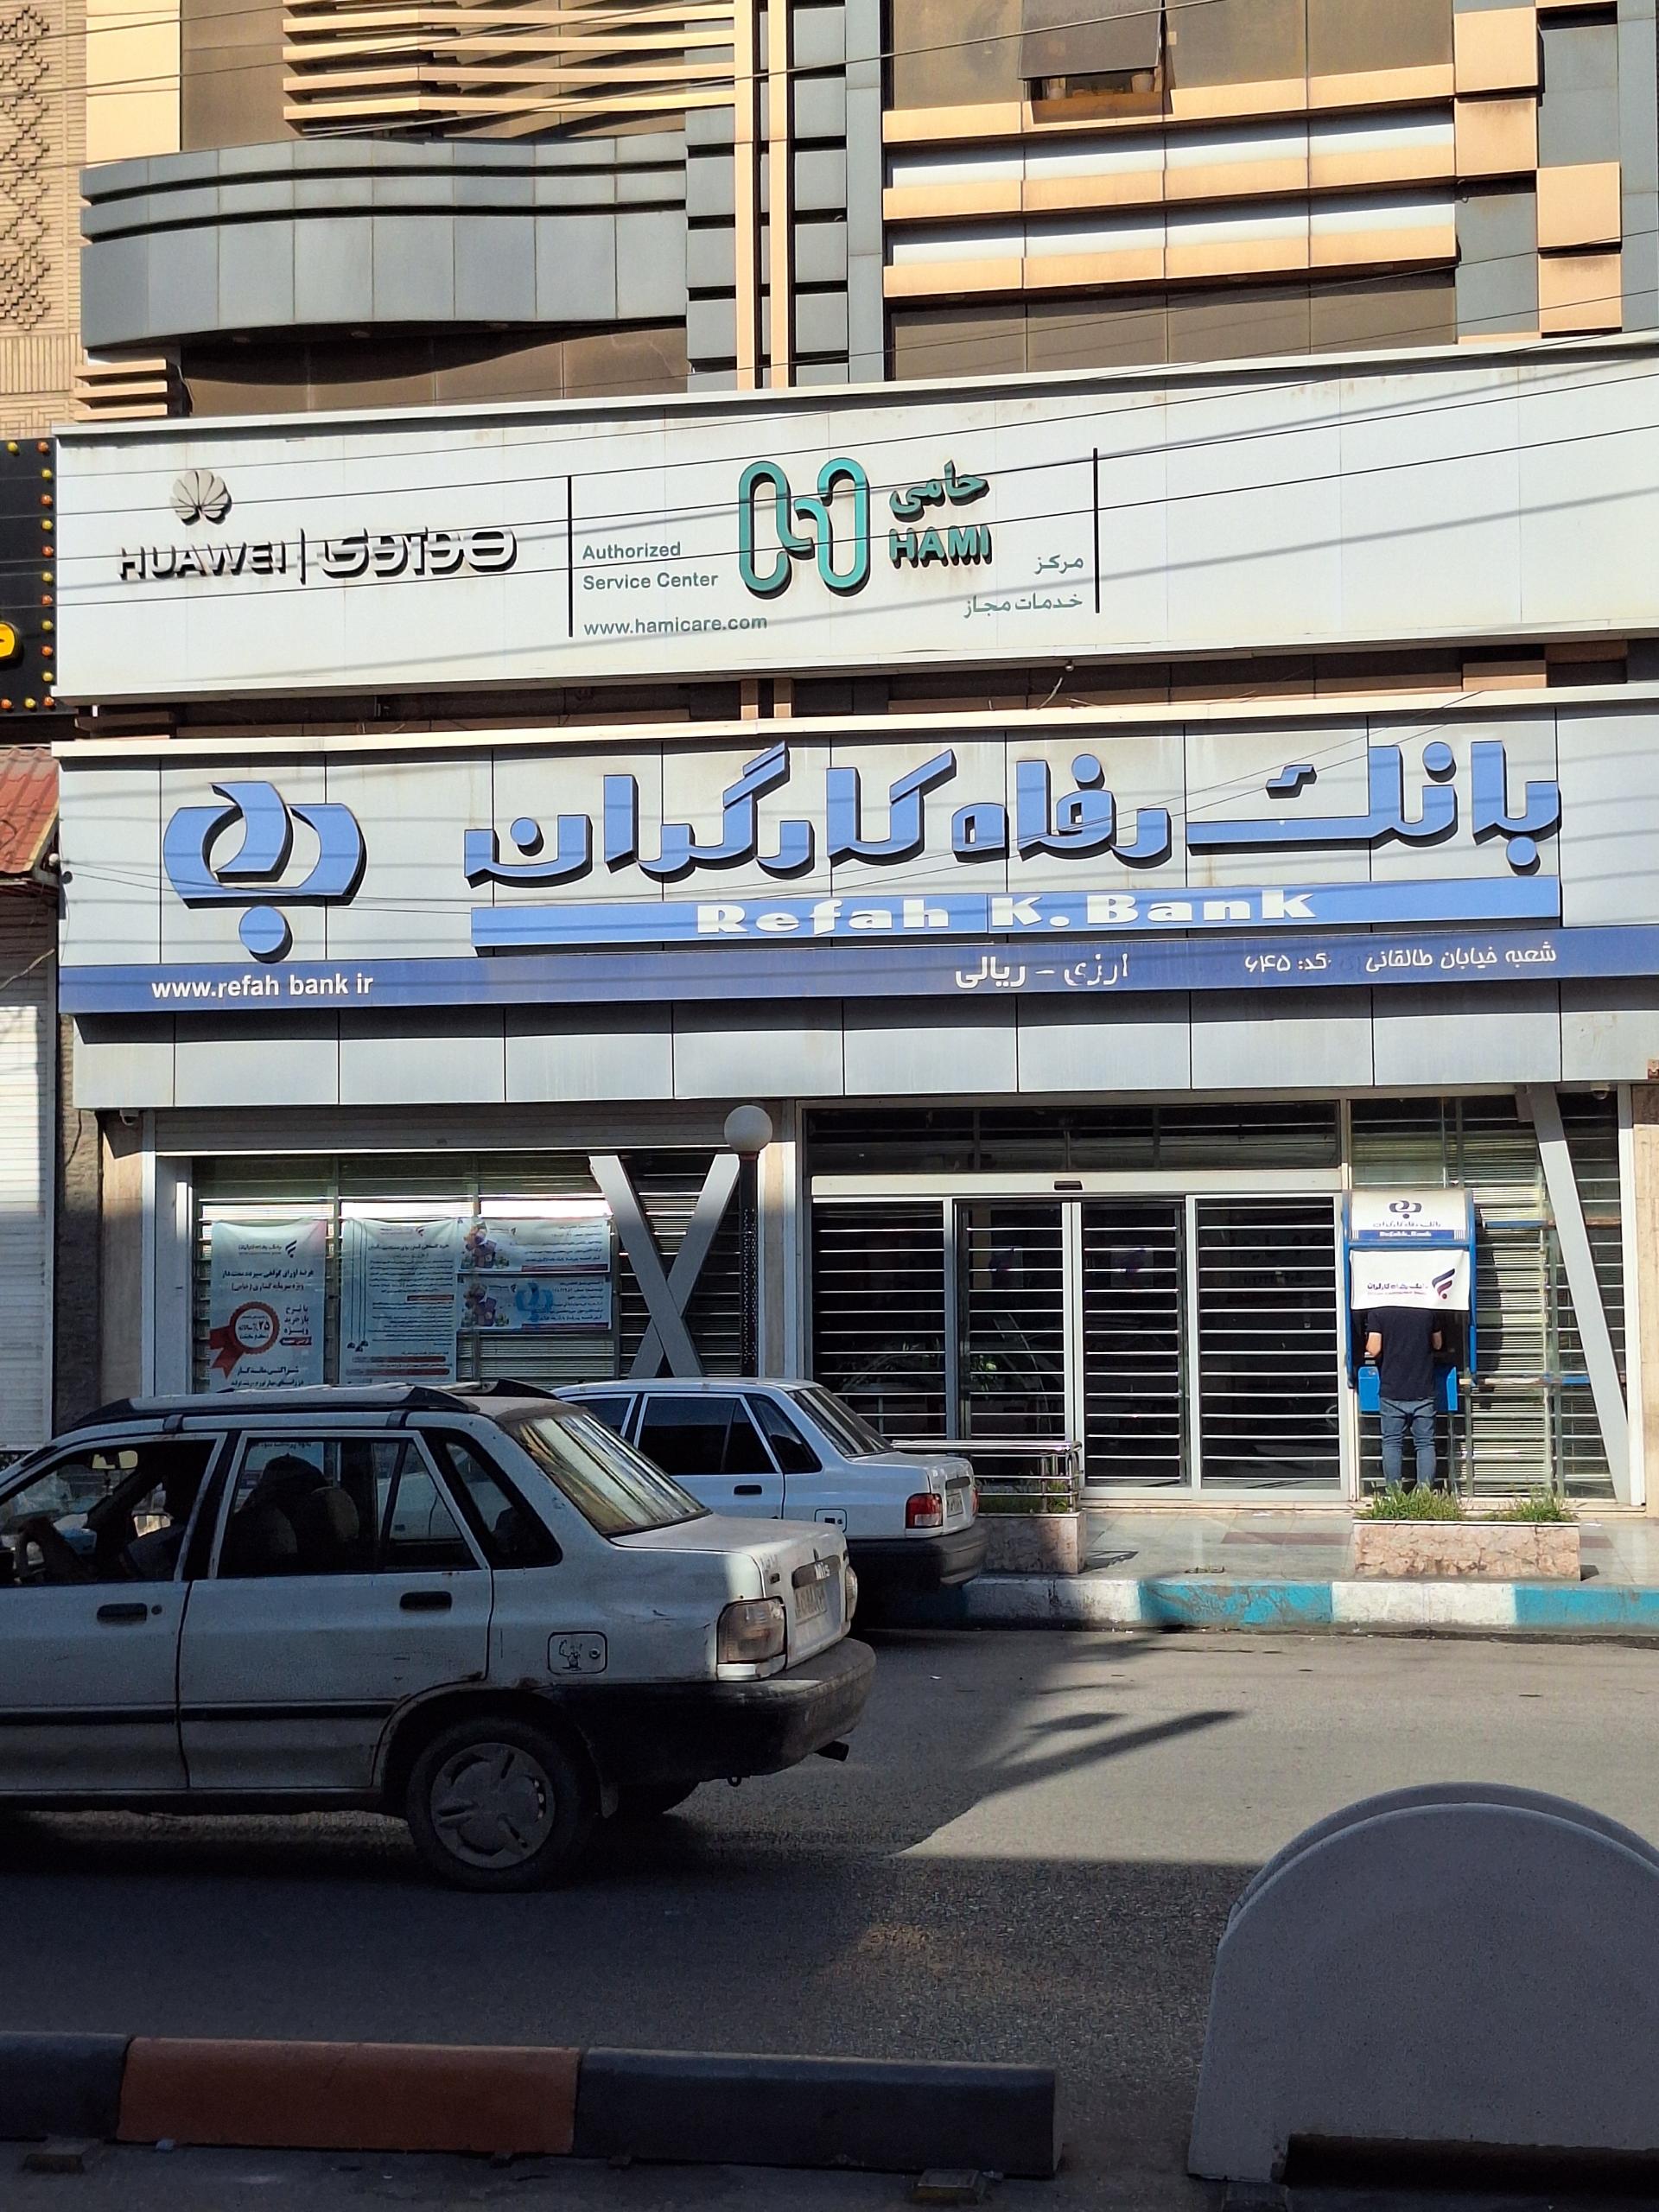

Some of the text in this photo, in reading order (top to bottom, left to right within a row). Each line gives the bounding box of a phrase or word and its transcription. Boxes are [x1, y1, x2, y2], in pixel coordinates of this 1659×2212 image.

[889, 460, 988, 518] حامی
[582, 542, 681, 560] Authorized
[889, 525, 992, 568] HAMI
[118, 542, 286, 580] HUAWEI
[1034, 555, 1084, 575] مرکز
[583, 571, 718, 590] Service Center
[963, 594, 1083, 618] خدمات مجاز
[584, 616, 767, 635] www.hamicare.com
[464, 741, 1560, 887] بانک رفاه کارگران
[696, 899, 949, 936] Refah
[1365, 950, 1433, 973] طالقانی
[1440, 947, 1497, 969] خیابان
[1505, 942, 1556, 968] شعبه
[956, 956, 1026, 988] ریالی
[1064, 953, 1128, 986] ارزی
[289, 973, 349, 996] bank
[356, 973, 373, 995] ir
